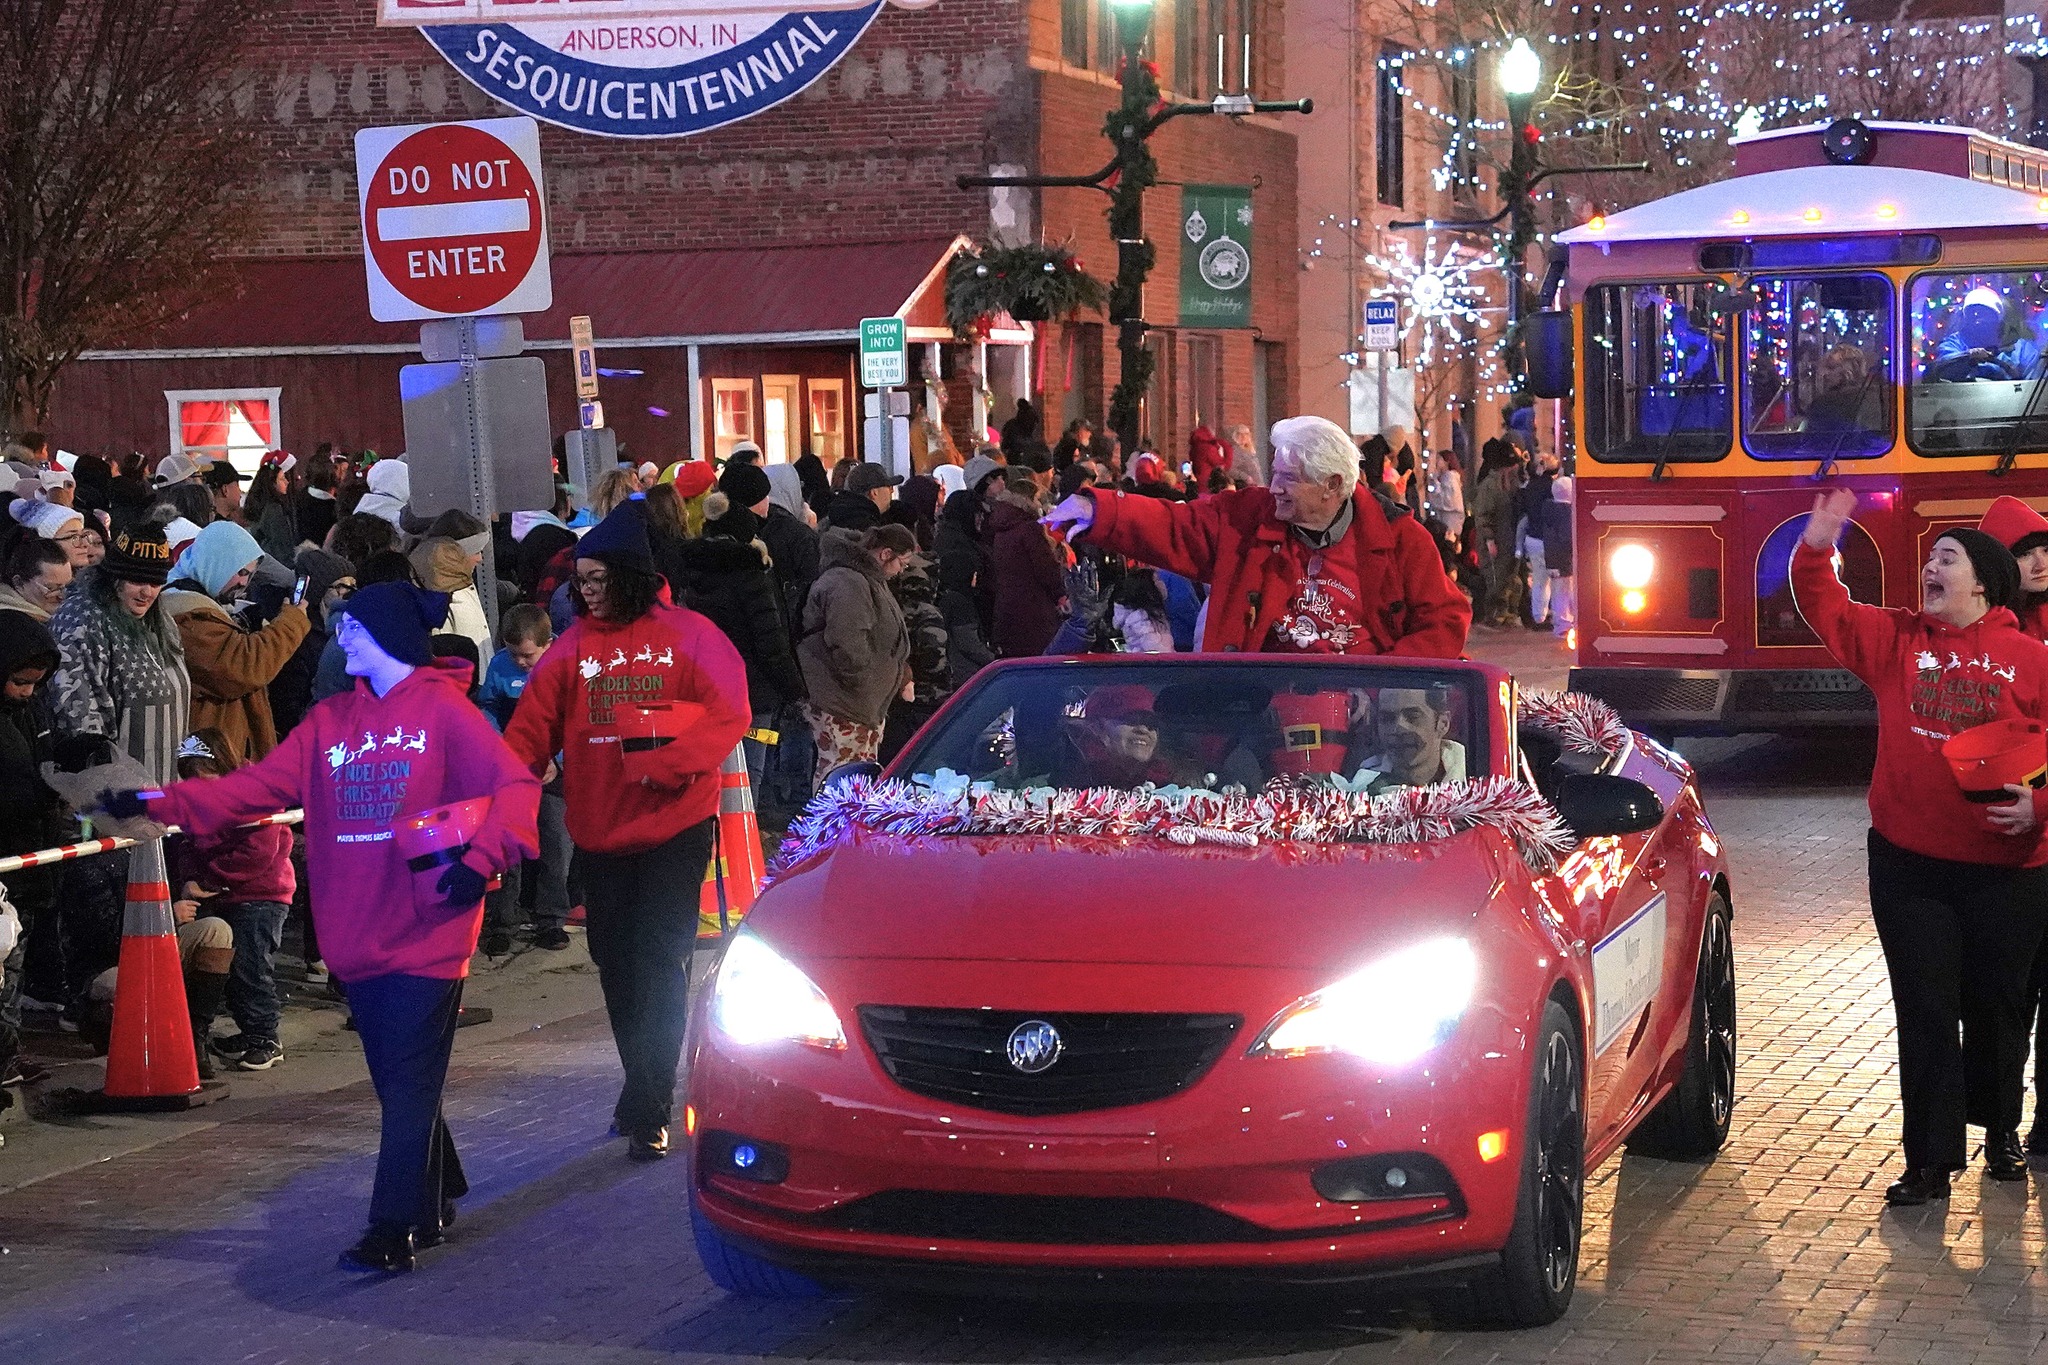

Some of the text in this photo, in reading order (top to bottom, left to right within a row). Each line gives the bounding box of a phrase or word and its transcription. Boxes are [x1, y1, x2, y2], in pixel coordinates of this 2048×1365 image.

[559, 23, 738, 52] ANDERSON, IN
[465, 14, 838, 120] SESQUICENTENNIAL
[388, 159, 511, 196] DO NOT
[407, 245, 507, 279] ENTER
[1367, 307, 1395, 319] RELAX
[867, 323, 898, 335] GROW
[870, 337, 895, 348] INTO
[867, 357, 899, 367] THE VERY
[867, 368, 899, 379] BEST YOU
[1917, 670, 2001, 698] ANERSON
[334, 781, 408, 803] CHRISMAS
